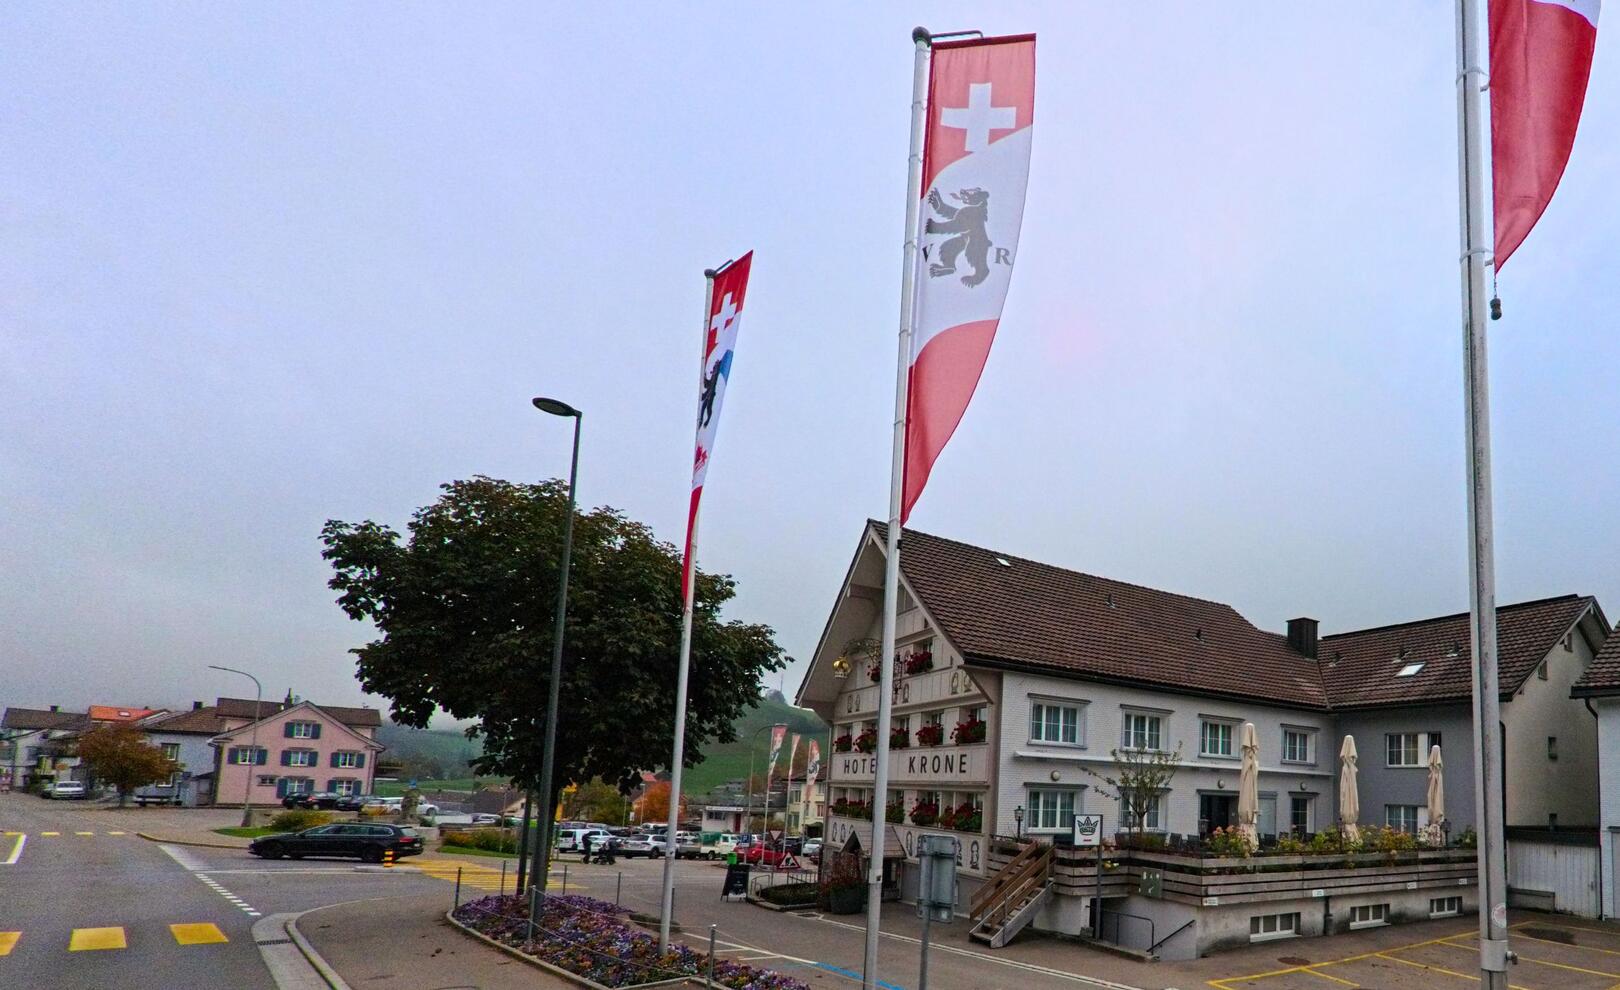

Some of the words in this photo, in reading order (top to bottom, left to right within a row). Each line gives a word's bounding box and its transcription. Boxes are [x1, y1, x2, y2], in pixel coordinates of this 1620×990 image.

[994, 247, 1011, 265] R
[844, 758, 877, 774] HOTE
[908, 754, 967, 774] KRONE
